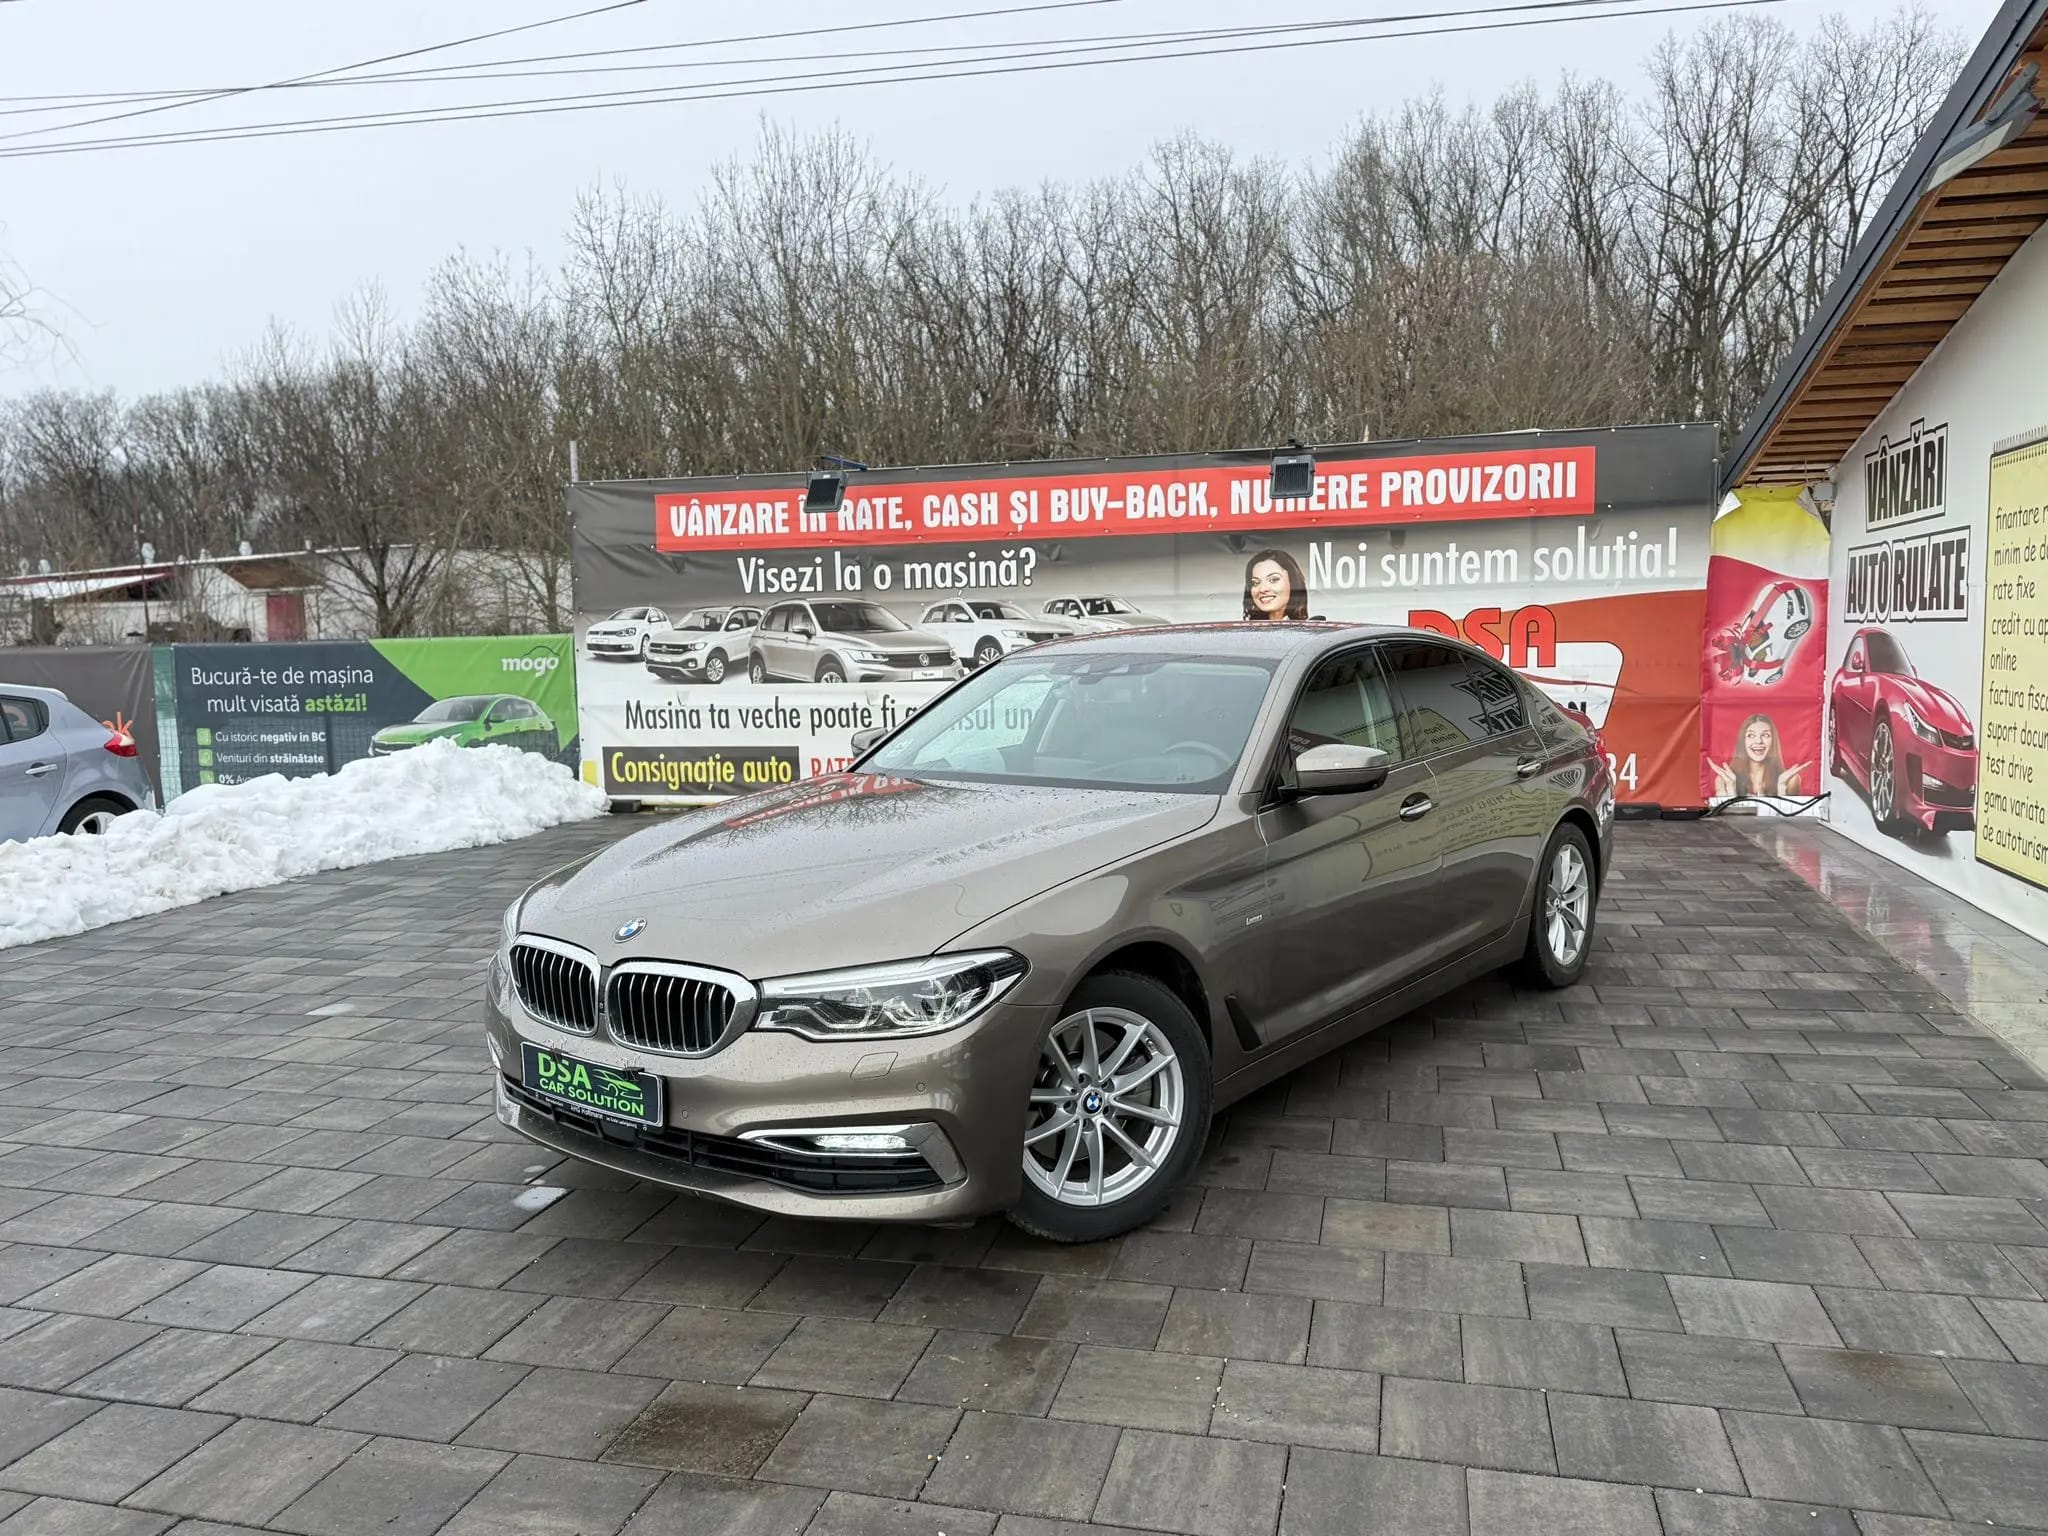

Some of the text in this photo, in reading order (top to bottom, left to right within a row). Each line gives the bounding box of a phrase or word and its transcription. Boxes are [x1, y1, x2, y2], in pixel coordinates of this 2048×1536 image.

[1868, 430, 1944, 523] VÂNZĂRI
[670, 499, 789, 537] VÂNZARE
[838, 497, 912, 531] RATE,
[923, 492, 998, 528] CASH
[1010, 490, 1038, 532] ȘI
[1050, 482, 1218, 523] BUY-BACK,
[1231, 474, 1367, 514] NUERE
[1381, 461, 1576, 507] PROVIZORII
[1995, 507, 2039, 532] finantare
[1309, 525, 1677, 590] Noi suntem soluția!
[1994, 535, 2048, 566] minim de d
[737, 556, 823, 593] Visezi
[834, 551, 861, 591] la
[873, 563, 892, 590] o
[1847, 537, 1967, 614] AUTO RULATE
[1993, 574, 2035, 600] rate fixe
[1992, 611, 2021, 636] credit
[2024, 618, 2035, 635] cu
[501, 656, 559, 678] mogo
[1990, 646, 2017, 671] online
[191, 665, 374, 688] Bucură-te de mașina
[207, 693, 367, 713] mult visată astăzi!
[1989, 681, 2024, 708] factura
[708, 703, 730, 729] ta
[738, 696, 801, 730] veche
[810, 701, 873, 736] poate
[881, 694, 896, 728] fi
[215, 731, 229, 742] Cu
[230, 731, 258, 742] istoric
[260, 731, 297, 744] negativ
[312, 731, 326, 742] BC
[1987, 720, 2017, 746] suport
[216, 752, 251, 763] Venituri
[253, 752, 268, 763] din
[611, 751, 735, 791] Consignație
[743, 755, 792, 784] auto
[1986, 752, 2033, 783] test drive
[219, 774, 234, 785] 0%
[1984, 789, 2045, 824] gama variata
[1983, 819, 1994, 842] de
[538, 1051, 592, 1090] DSA
[539, 1077, 565, 1095] CAR
[568, 1085, 644, 1116] SOLUTION
